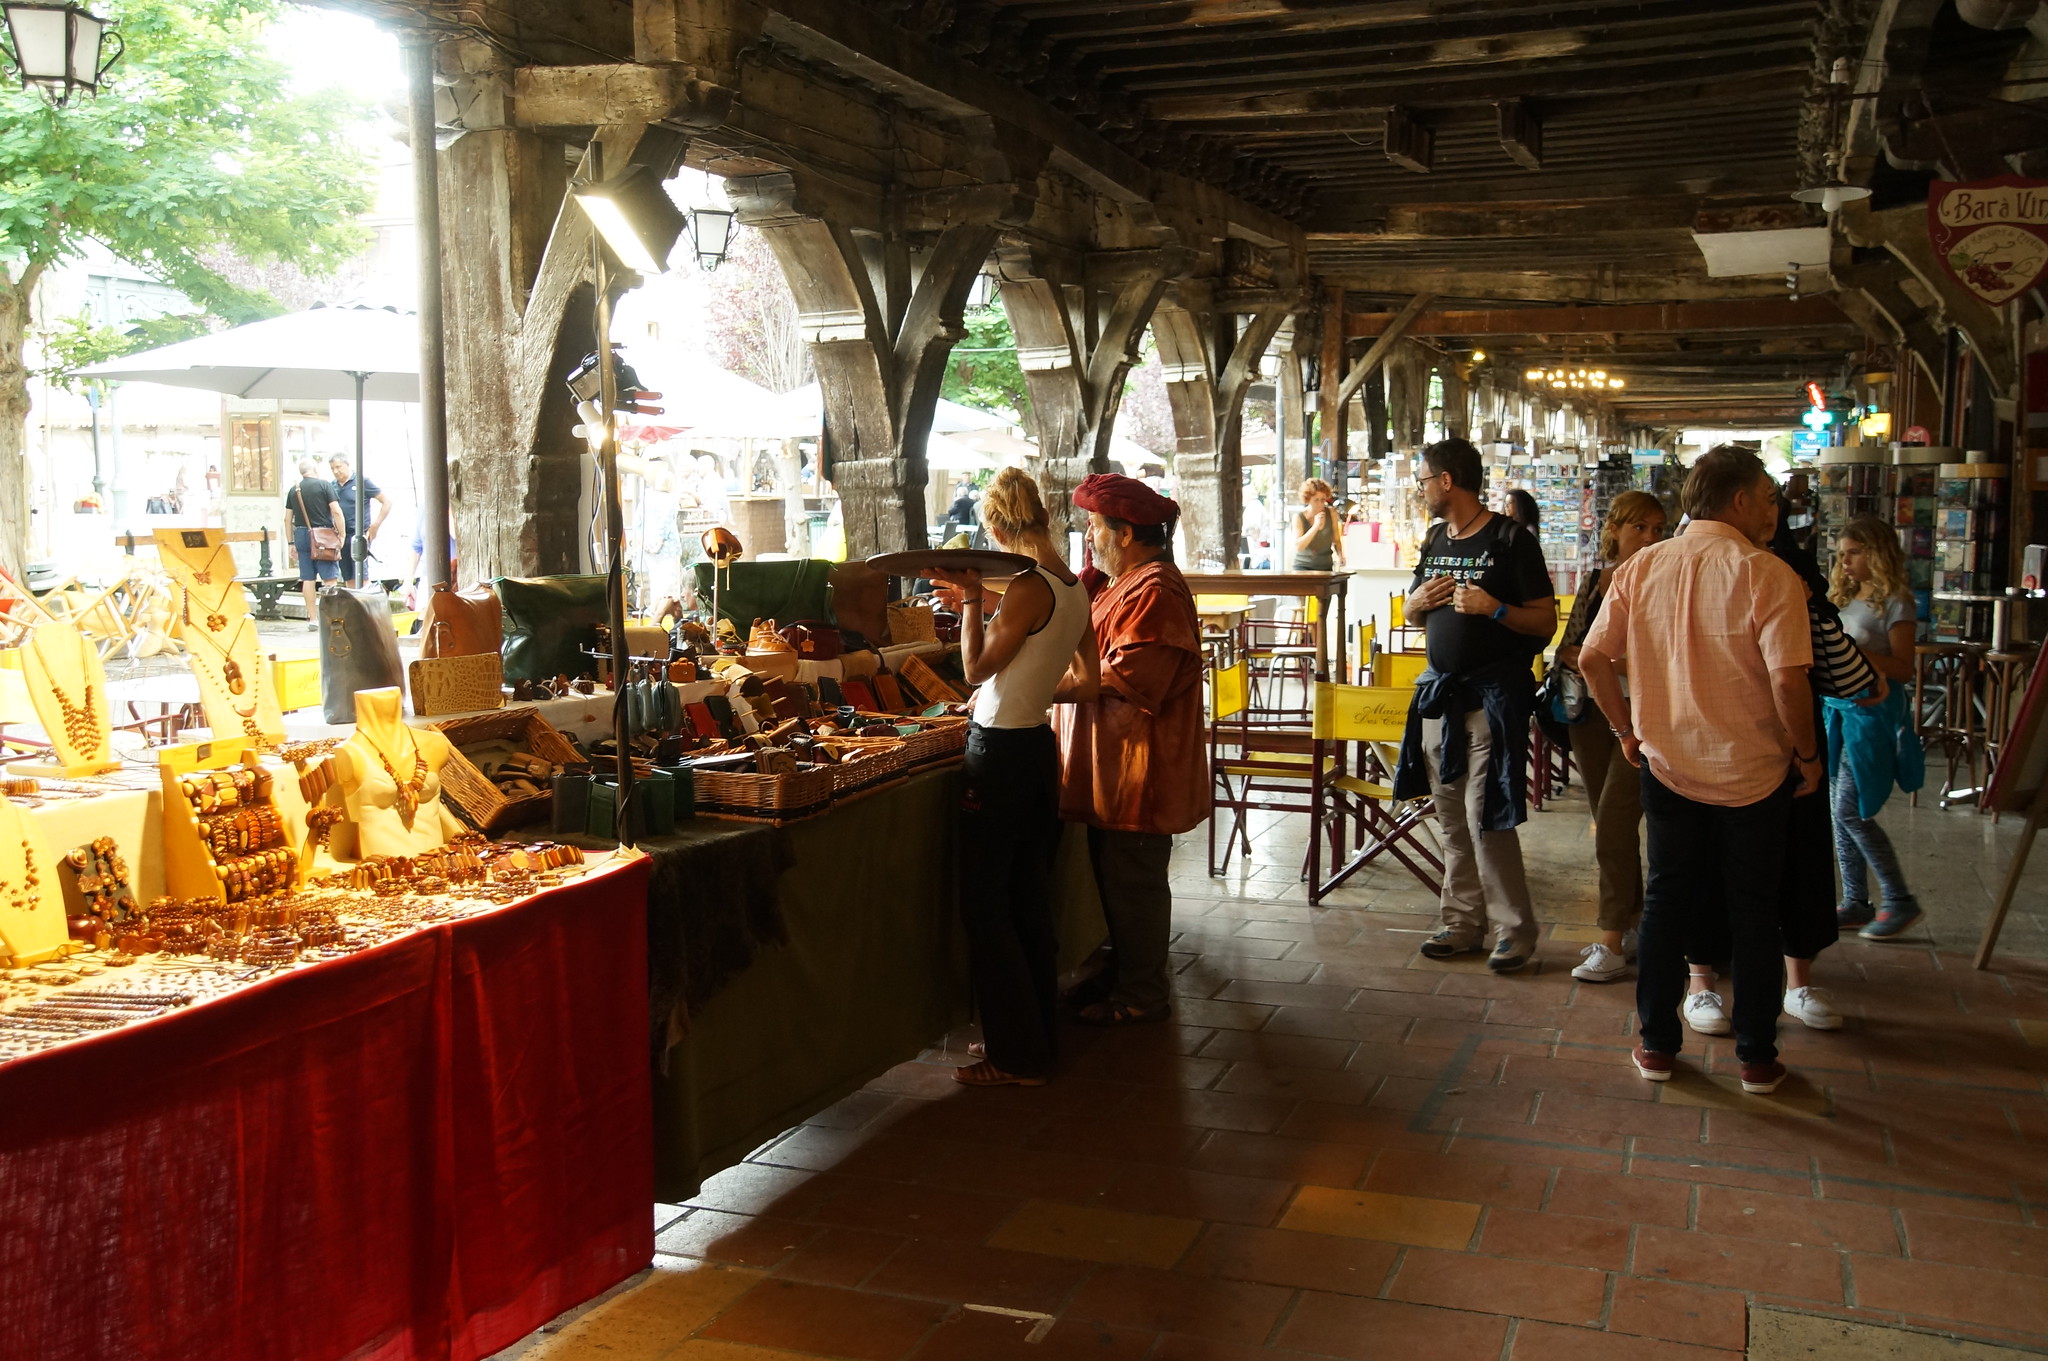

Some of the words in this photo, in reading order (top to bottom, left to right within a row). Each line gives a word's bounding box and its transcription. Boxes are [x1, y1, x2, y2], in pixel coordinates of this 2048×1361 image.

[1954, 192, 1998, 223] Bar
[1998, 197, 2010, 218] à
[1353, 713, 1377, 725] Des
